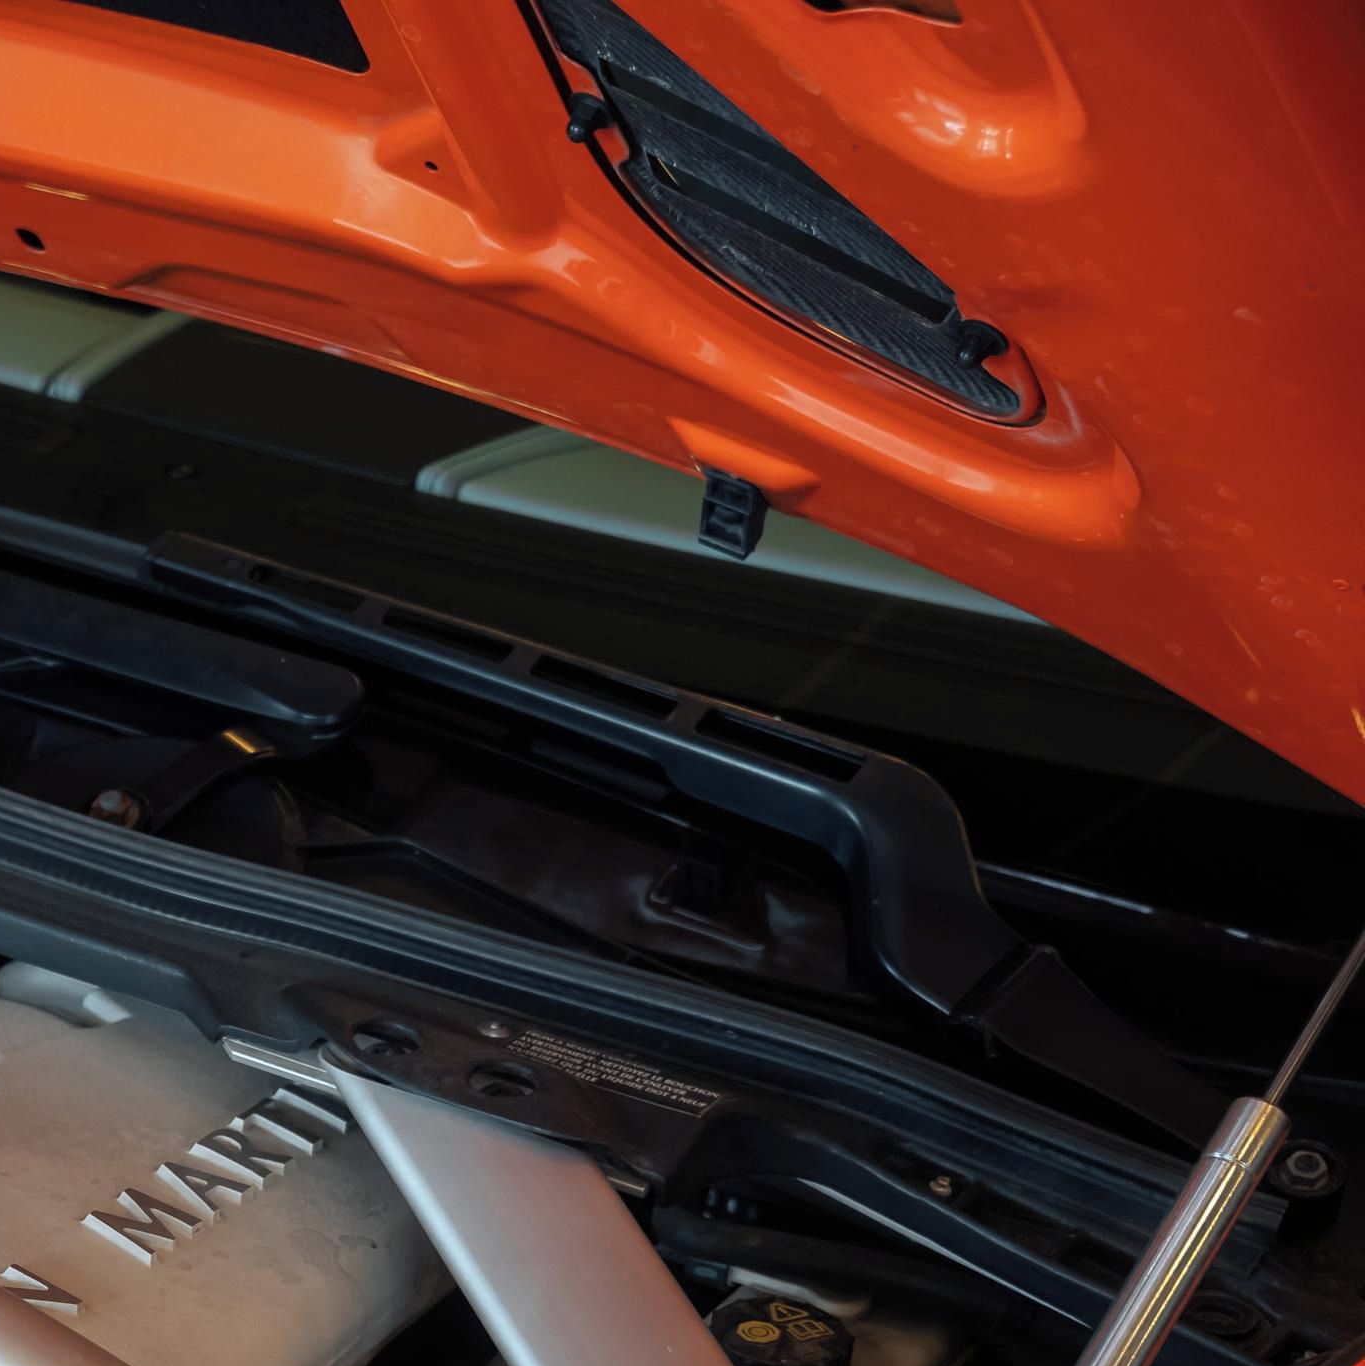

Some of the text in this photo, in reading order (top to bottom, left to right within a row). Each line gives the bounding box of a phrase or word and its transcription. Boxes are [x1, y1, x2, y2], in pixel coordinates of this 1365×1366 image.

[582, 1061, 620, 1077] AVANT
[598, 1059, 651, 1079] NETTOYEZ
[663, 1079, 721, 1099] BOUCHON
[600, 1073, 646, 1091] LIQUIDE
[79, 1082, 355, 1269] MARTI
